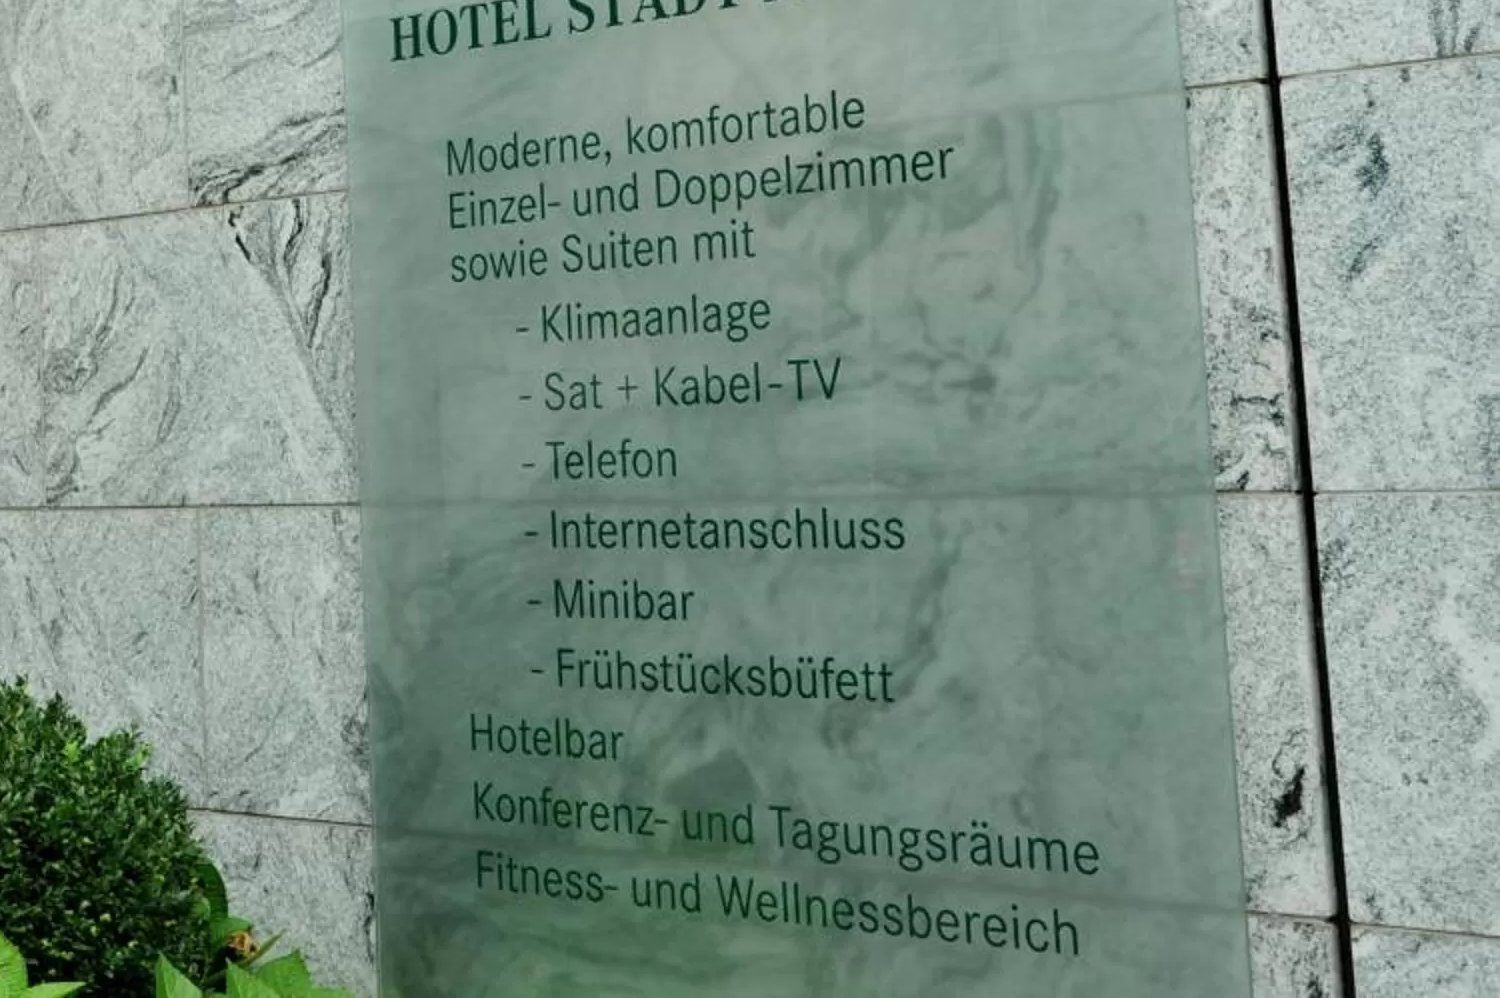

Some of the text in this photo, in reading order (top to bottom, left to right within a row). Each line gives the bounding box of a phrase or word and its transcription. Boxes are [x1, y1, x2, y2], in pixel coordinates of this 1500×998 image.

[446, 89, 865, 177] Moderne, komfortable
[449, 146, 955, 230] Einzel- und Doppelzimmer
[451, 218, 757, 283] sowie Suiten mit
[541, 293, 771, 343] Klimaanlage
[544, 371, 603, 411] Sat
[655, 355, 842, 407] Kabel-TV
[545, 438, 677, 480] Telefon
[550, 507, 906, 551] Internetanschluss
[553, 578, 695, 621] Minibar
[556, 647, 896, 704] Frühstücksbüfett
[470, 713, 624, 761] Hotelbar
[473, 781, 1100, 876] Konferenz- und Tagungsräume
[476, 849, 1079, 957] Fitness- und Wellnessbereich
